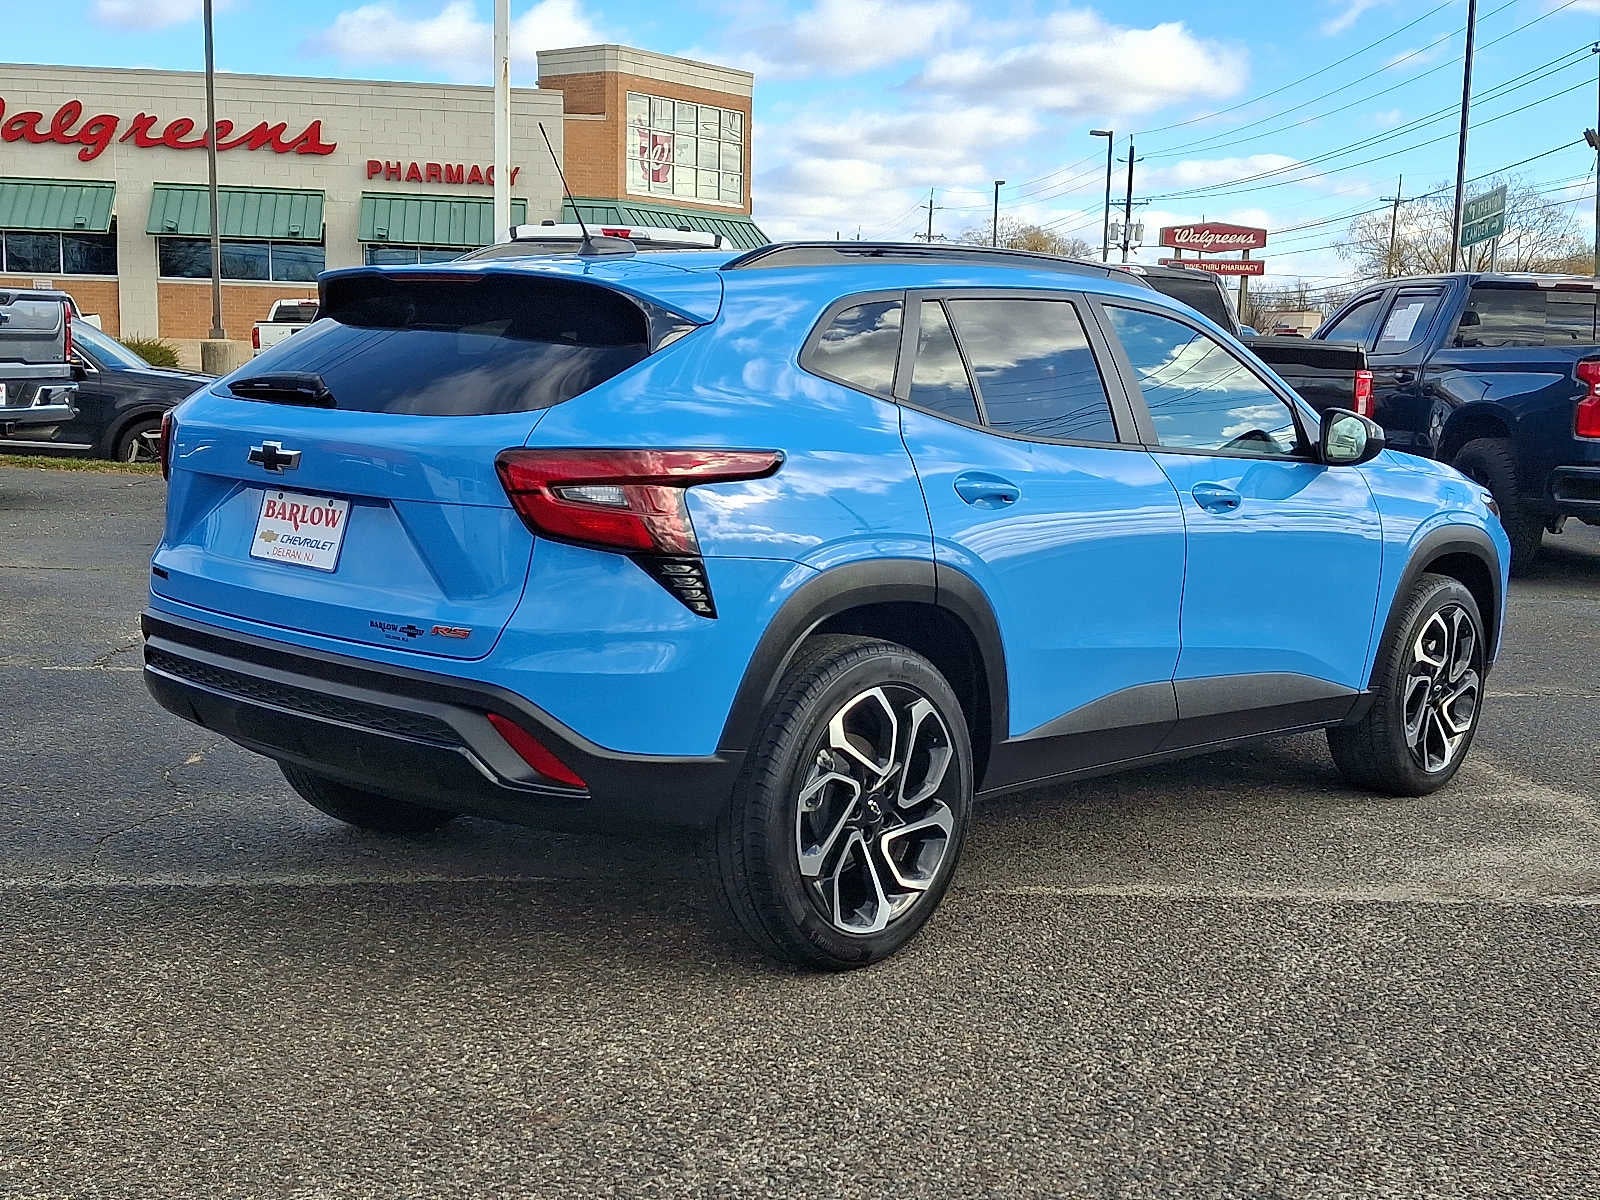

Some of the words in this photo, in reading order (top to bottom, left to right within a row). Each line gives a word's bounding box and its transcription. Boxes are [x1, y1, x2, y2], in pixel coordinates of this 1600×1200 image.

[0, 97, 337, 162] algreens
[1173, 227, 1257, 248] Walgreens
[1220, 263, 1259, 272] PHARMACY
[264, 499, 343, 532] BARLOW
[280, 534, 335, 552] CHEVROLET
[304, 552, 314, 562] NJ
[369, 619, 399, 633] BARLOW
[430, 624, 473, 640] RS
